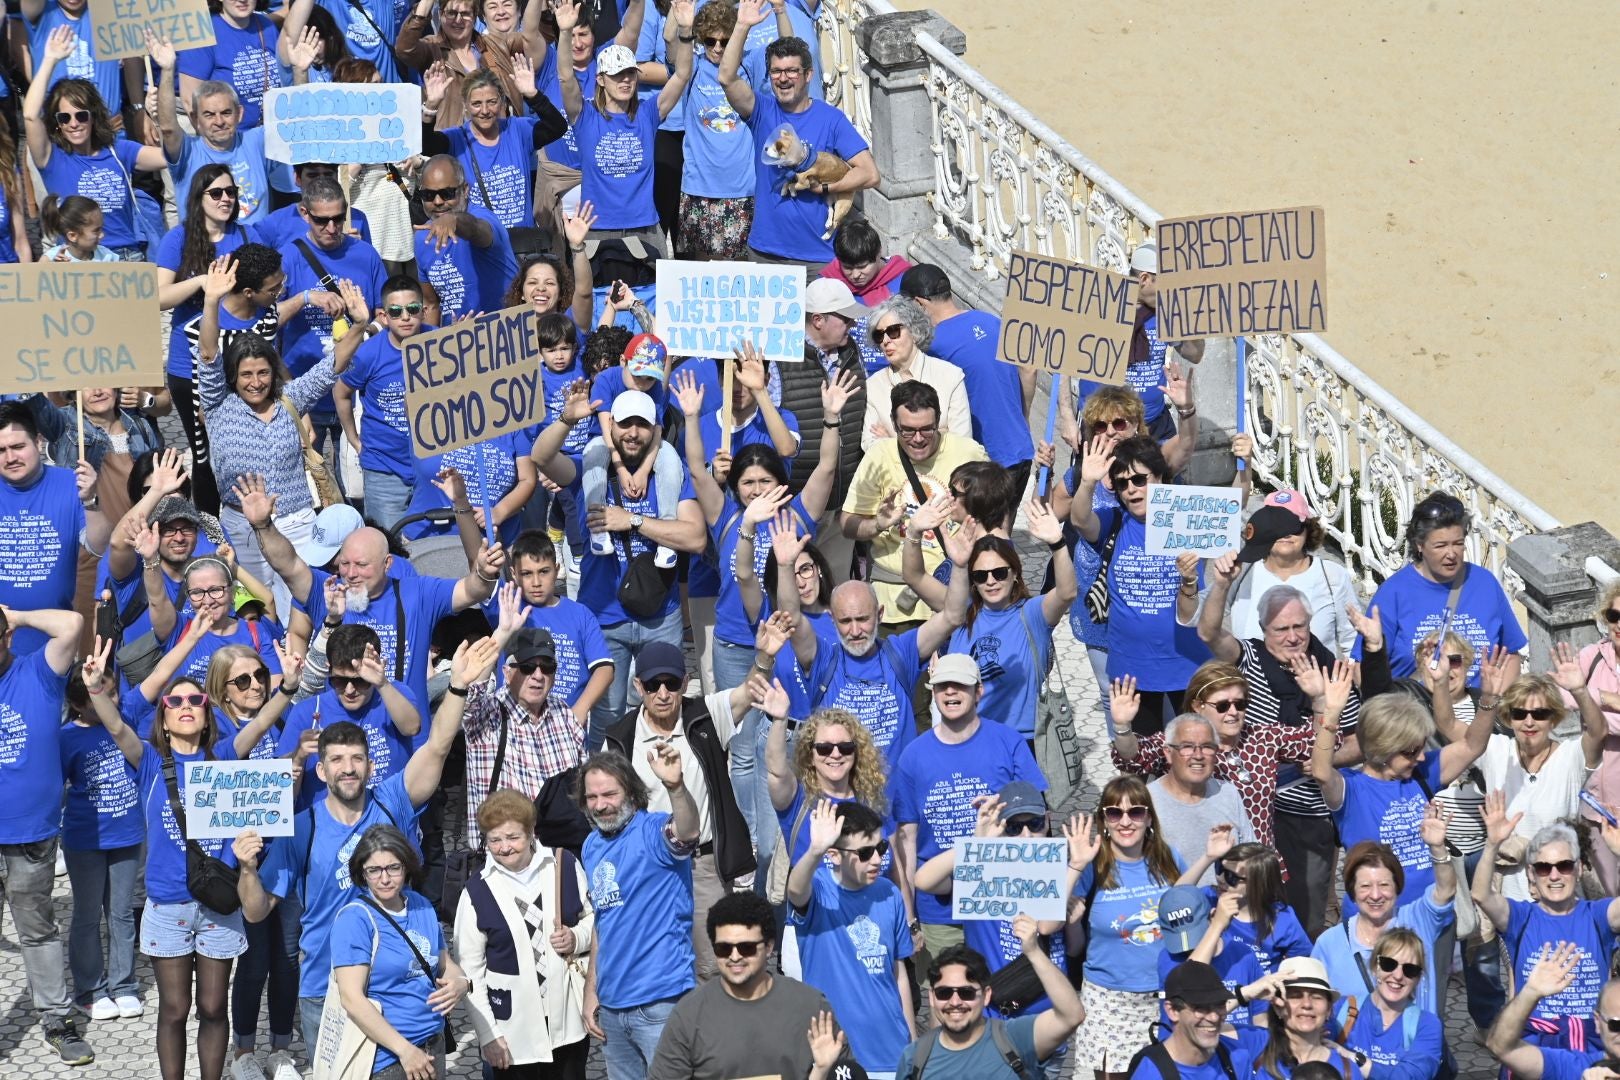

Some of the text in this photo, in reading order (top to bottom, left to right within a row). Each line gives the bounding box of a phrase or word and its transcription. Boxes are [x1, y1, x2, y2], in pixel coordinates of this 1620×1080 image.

[1159, 210, 1315, 273] ERRESPETATU
[37, 271, 155, 300] AUTISMO
[679, 274, 797, 299] HAGAMOS
[664, 299, 802, 324] VISIBLE LO
[1238, 279, 1326, 333] BEZALA
[42, 308, 95, 338] NO
[16, 342, 137, 382] SE CURA
[1003, 319, 1126, 379] COMO SOY
[415, 390, 485, 450] COMO
[490, 369, 537, 428] SOY
[1151, 488, 1240, 514] EL AUTISMO
[1152, 510, 1229, 530] SE HACE
[190, 766, 292, 790] EL AUTISMO
[194, 790, 281, 808] SE HACE
[954, 864, 984, 882] ERE
[972, 876, 1059, 899] AUTISMOA
